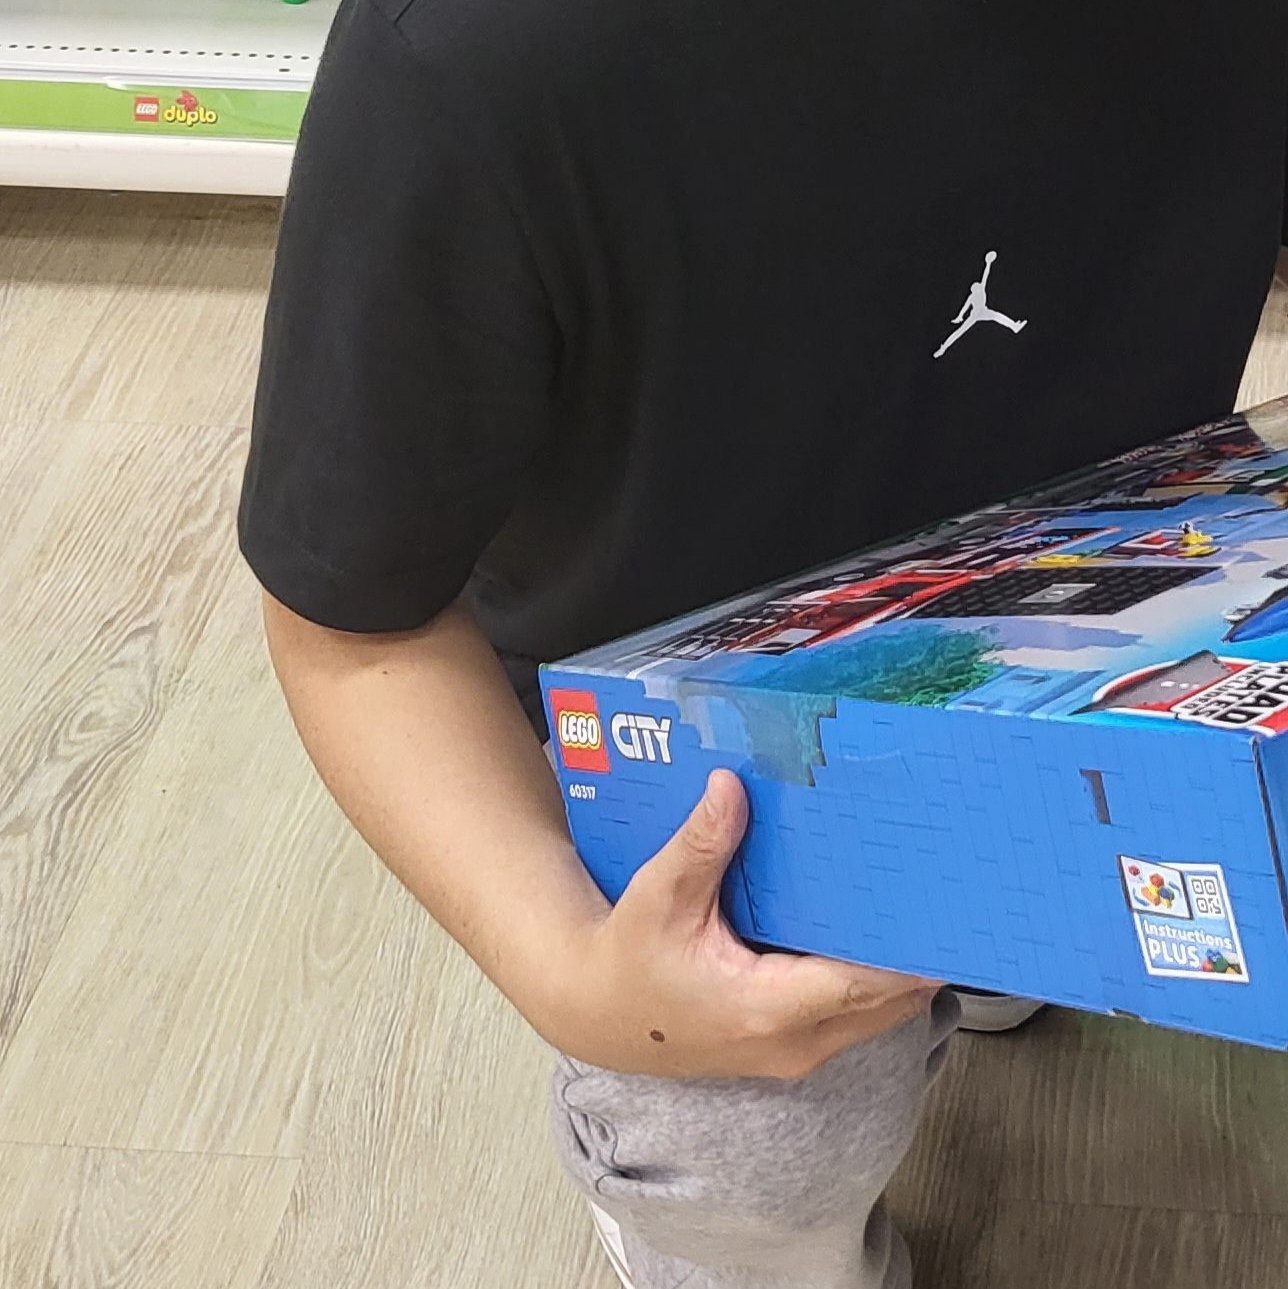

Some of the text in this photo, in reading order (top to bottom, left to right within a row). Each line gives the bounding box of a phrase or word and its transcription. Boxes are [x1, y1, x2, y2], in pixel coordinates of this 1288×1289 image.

[163, 105, 218, 127] duplo
[558, 712, 602, 749] LEGO
[611, 713, 673, 765] CITY
[568, 783, 597, 801] 60317
[1143, 919, 1234, 951] Instructions
[1146, 936, 1201, 970] PLUS
